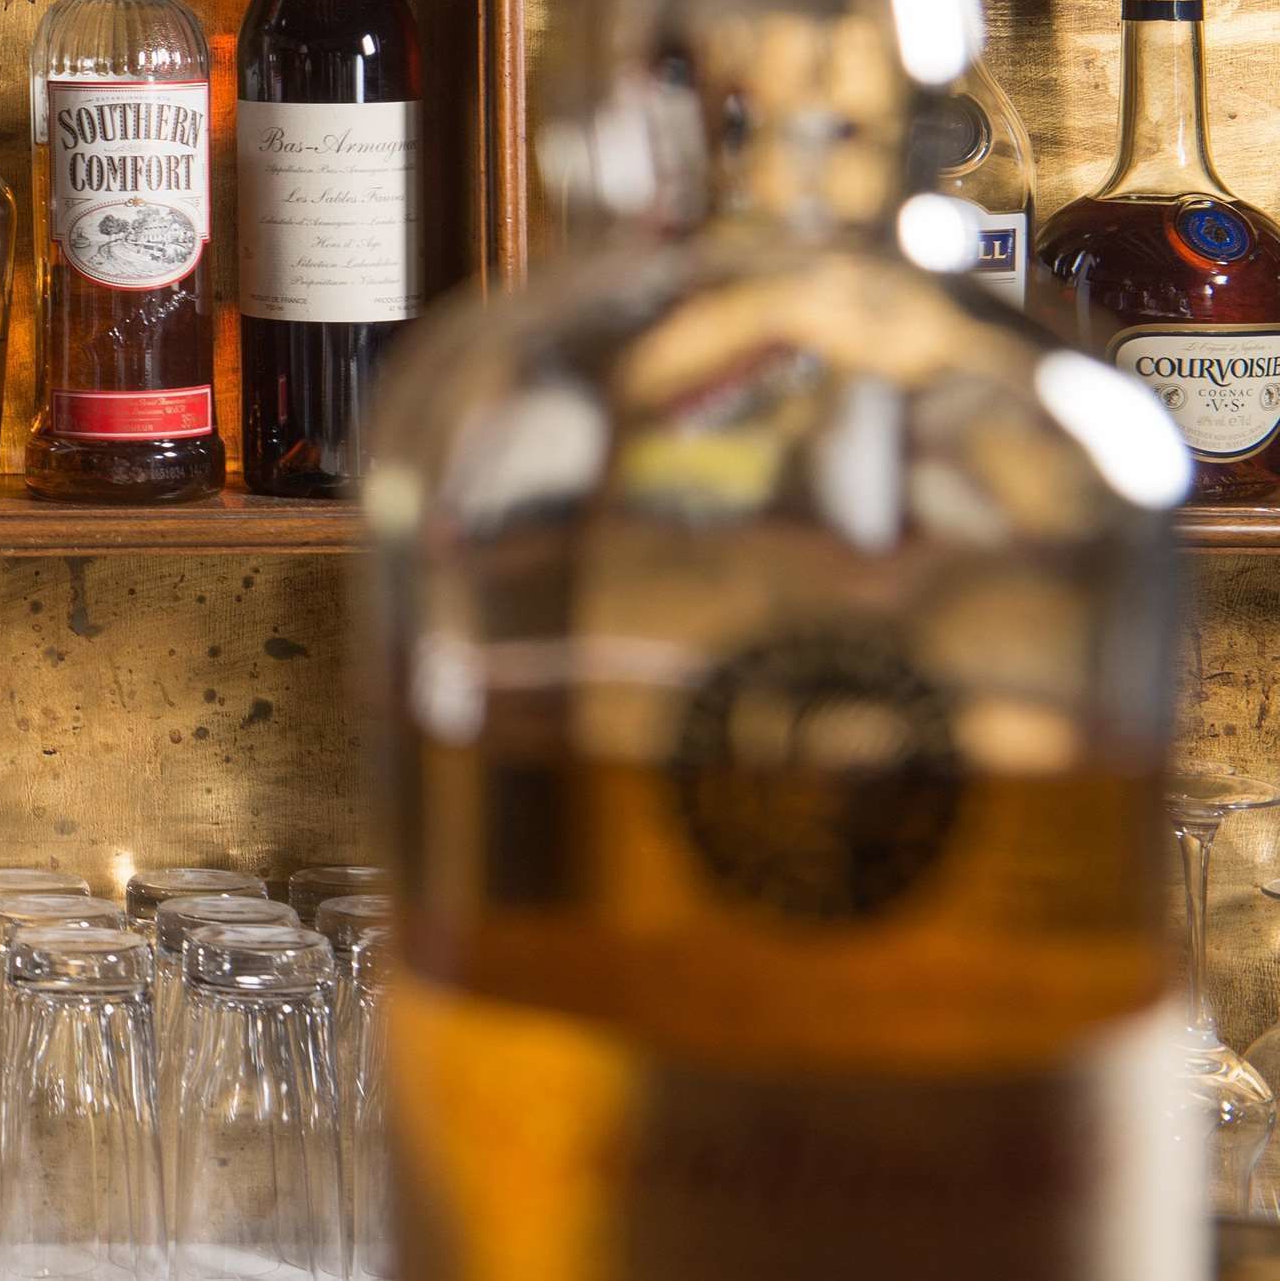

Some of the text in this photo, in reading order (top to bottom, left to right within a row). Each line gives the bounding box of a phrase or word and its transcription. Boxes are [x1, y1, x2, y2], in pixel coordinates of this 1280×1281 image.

[57, 102, 204, 151] SOUTHERN
[69, 152, 194, 192] COMFORT
[283, 187, 358, 204] Les Sables
[1135, 356, 1280, 388] COURVOISIE
[1198, 388, 1254, 398] COGNAC
